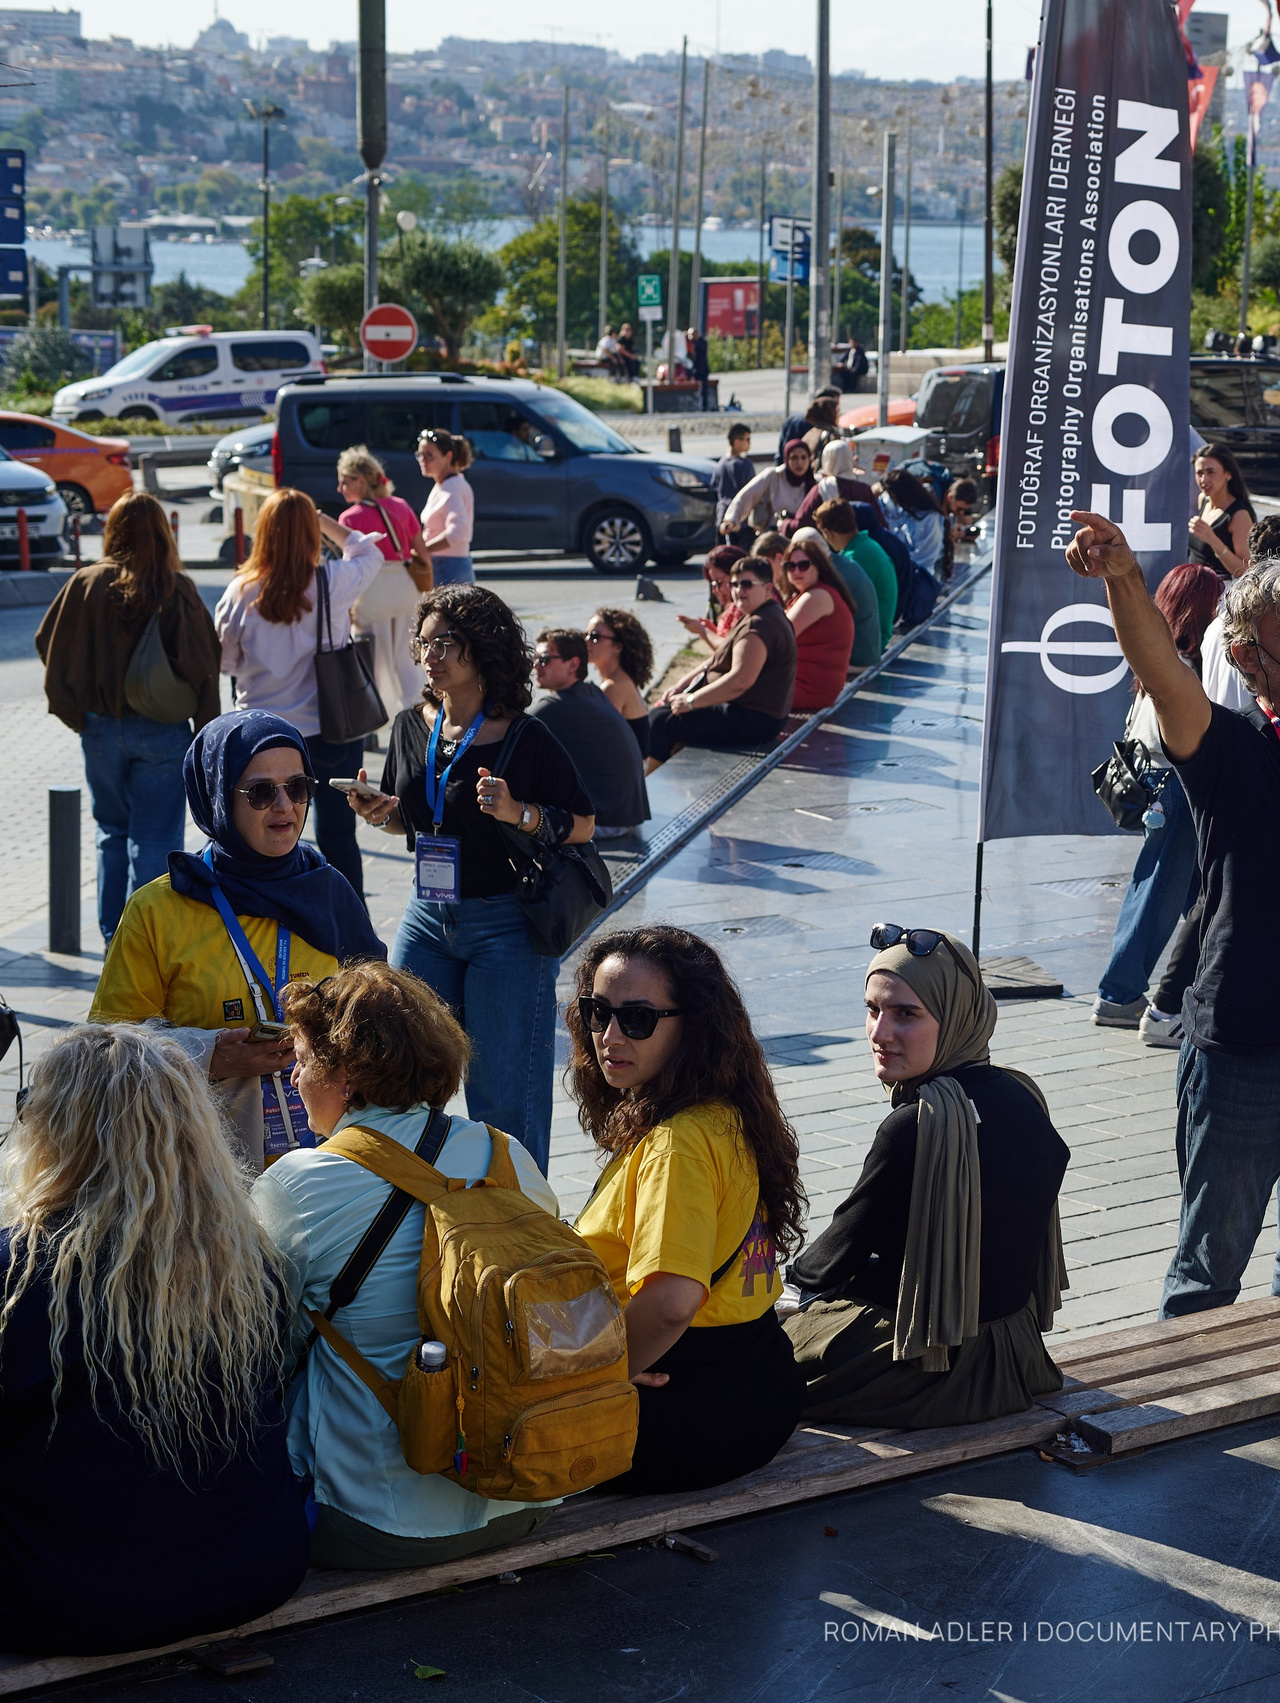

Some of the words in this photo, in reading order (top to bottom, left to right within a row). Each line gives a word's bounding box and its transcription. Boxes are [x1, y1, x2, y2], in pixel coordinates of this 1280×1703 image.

[1048, 87, 1077, 190] DERNEĞİ
[1080, 95, 1106, 231] Association
[1029, 196, 1067, 426] ORGANİZASYONLARI
[1063, 238, 1095, 399] Organisations
[1090, 99, 1181, 551] FOTON
[1016, 430, 1044, 548] FOTOĞRAF
[1051, 405, 1084, 550] Photography
[462, 727, 476, 747] vivo
[435, 891, 455, 899] vivo
[271, 1090, 300, 1099] vvo
